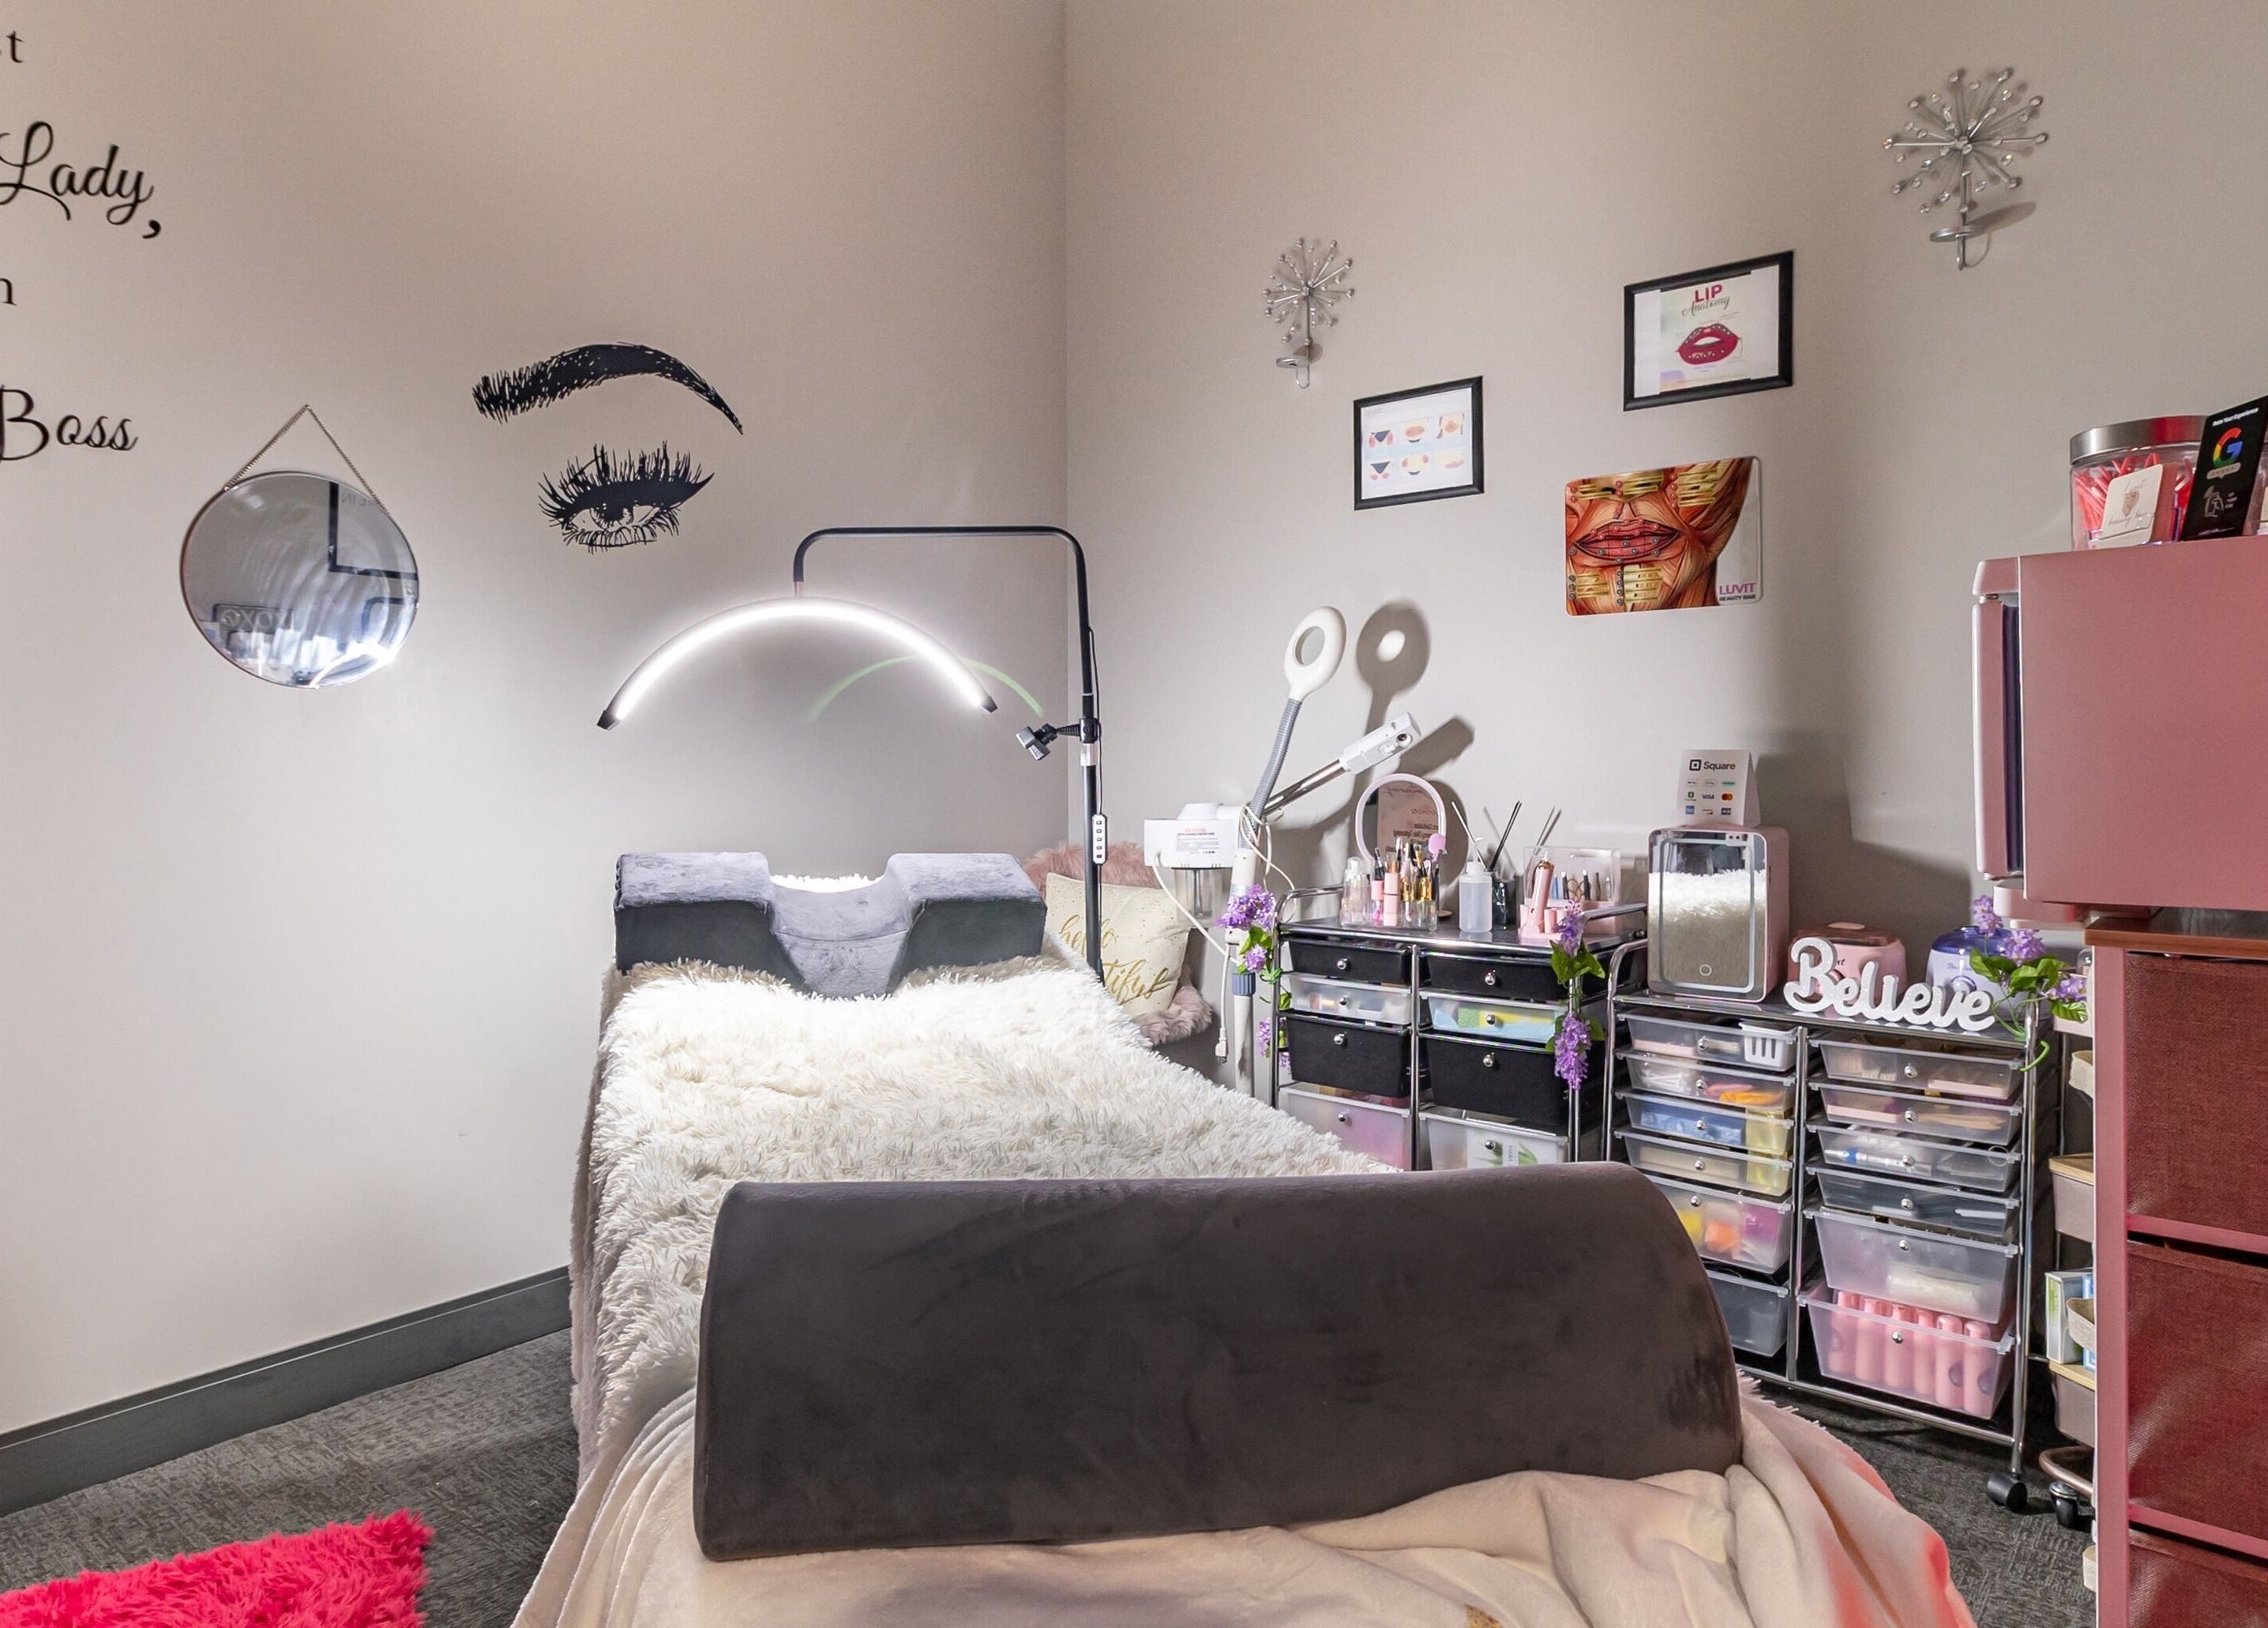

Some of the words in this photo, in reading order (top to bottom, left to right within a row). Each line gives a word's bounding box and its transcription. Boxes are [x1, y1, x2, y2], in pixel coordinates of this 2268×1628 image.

[0, 121, 162, 239] Lady,
[1695, 284, 1722, 303] LIP
[1681, 297, 1729, 317] Anatomy
[0, 384, 138, 464] Boss
[1719, 582, 1757, 595] LUVIT
[1703, 761, 1736, 771] Square
[1783, 937, 1996, 1032] Believe
